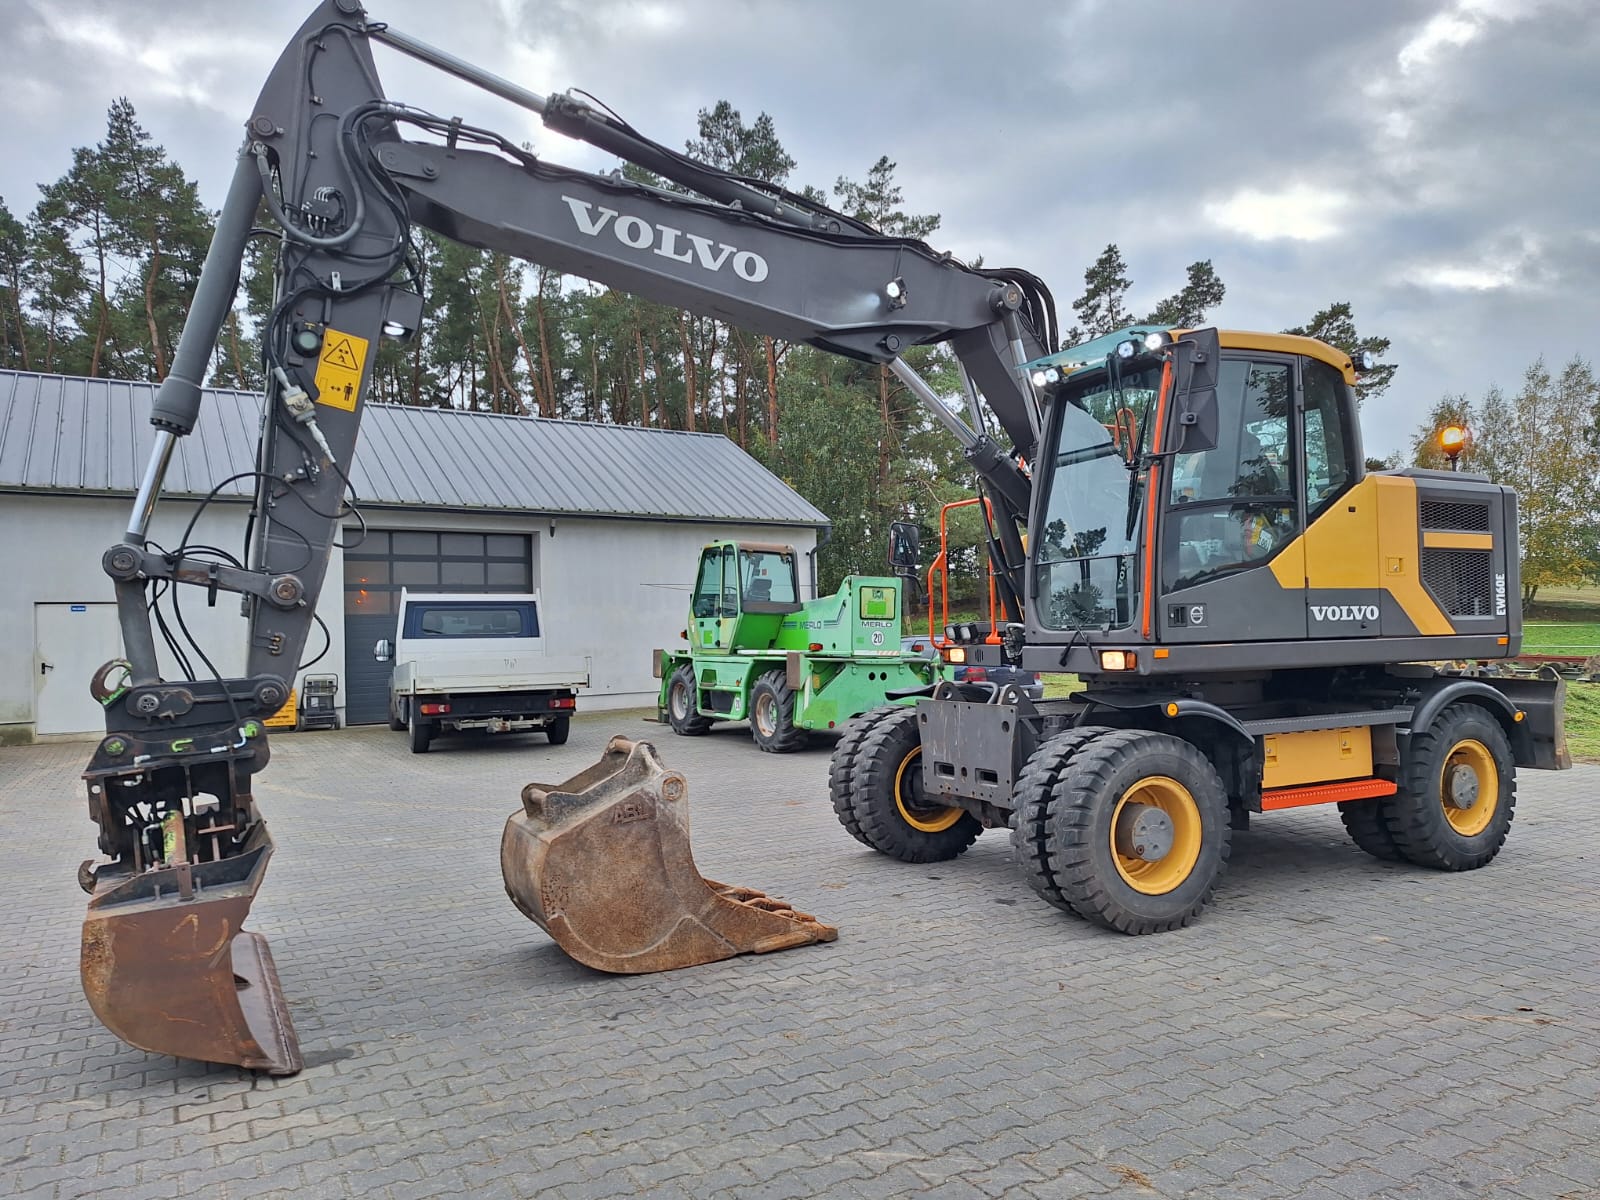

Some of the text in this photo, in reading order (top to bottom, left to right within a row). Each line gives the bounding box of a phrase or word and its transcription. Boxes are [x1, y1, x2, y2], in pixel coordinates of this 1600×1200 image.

[561, 195, 769, 283] VOLVO
[1495, 573, 1506, 616] EW160E
[1310, 605, 1379, 621] VOLVO
[800, 620, 822, 631] MERLO
[873, 633, 883, 644] 20
